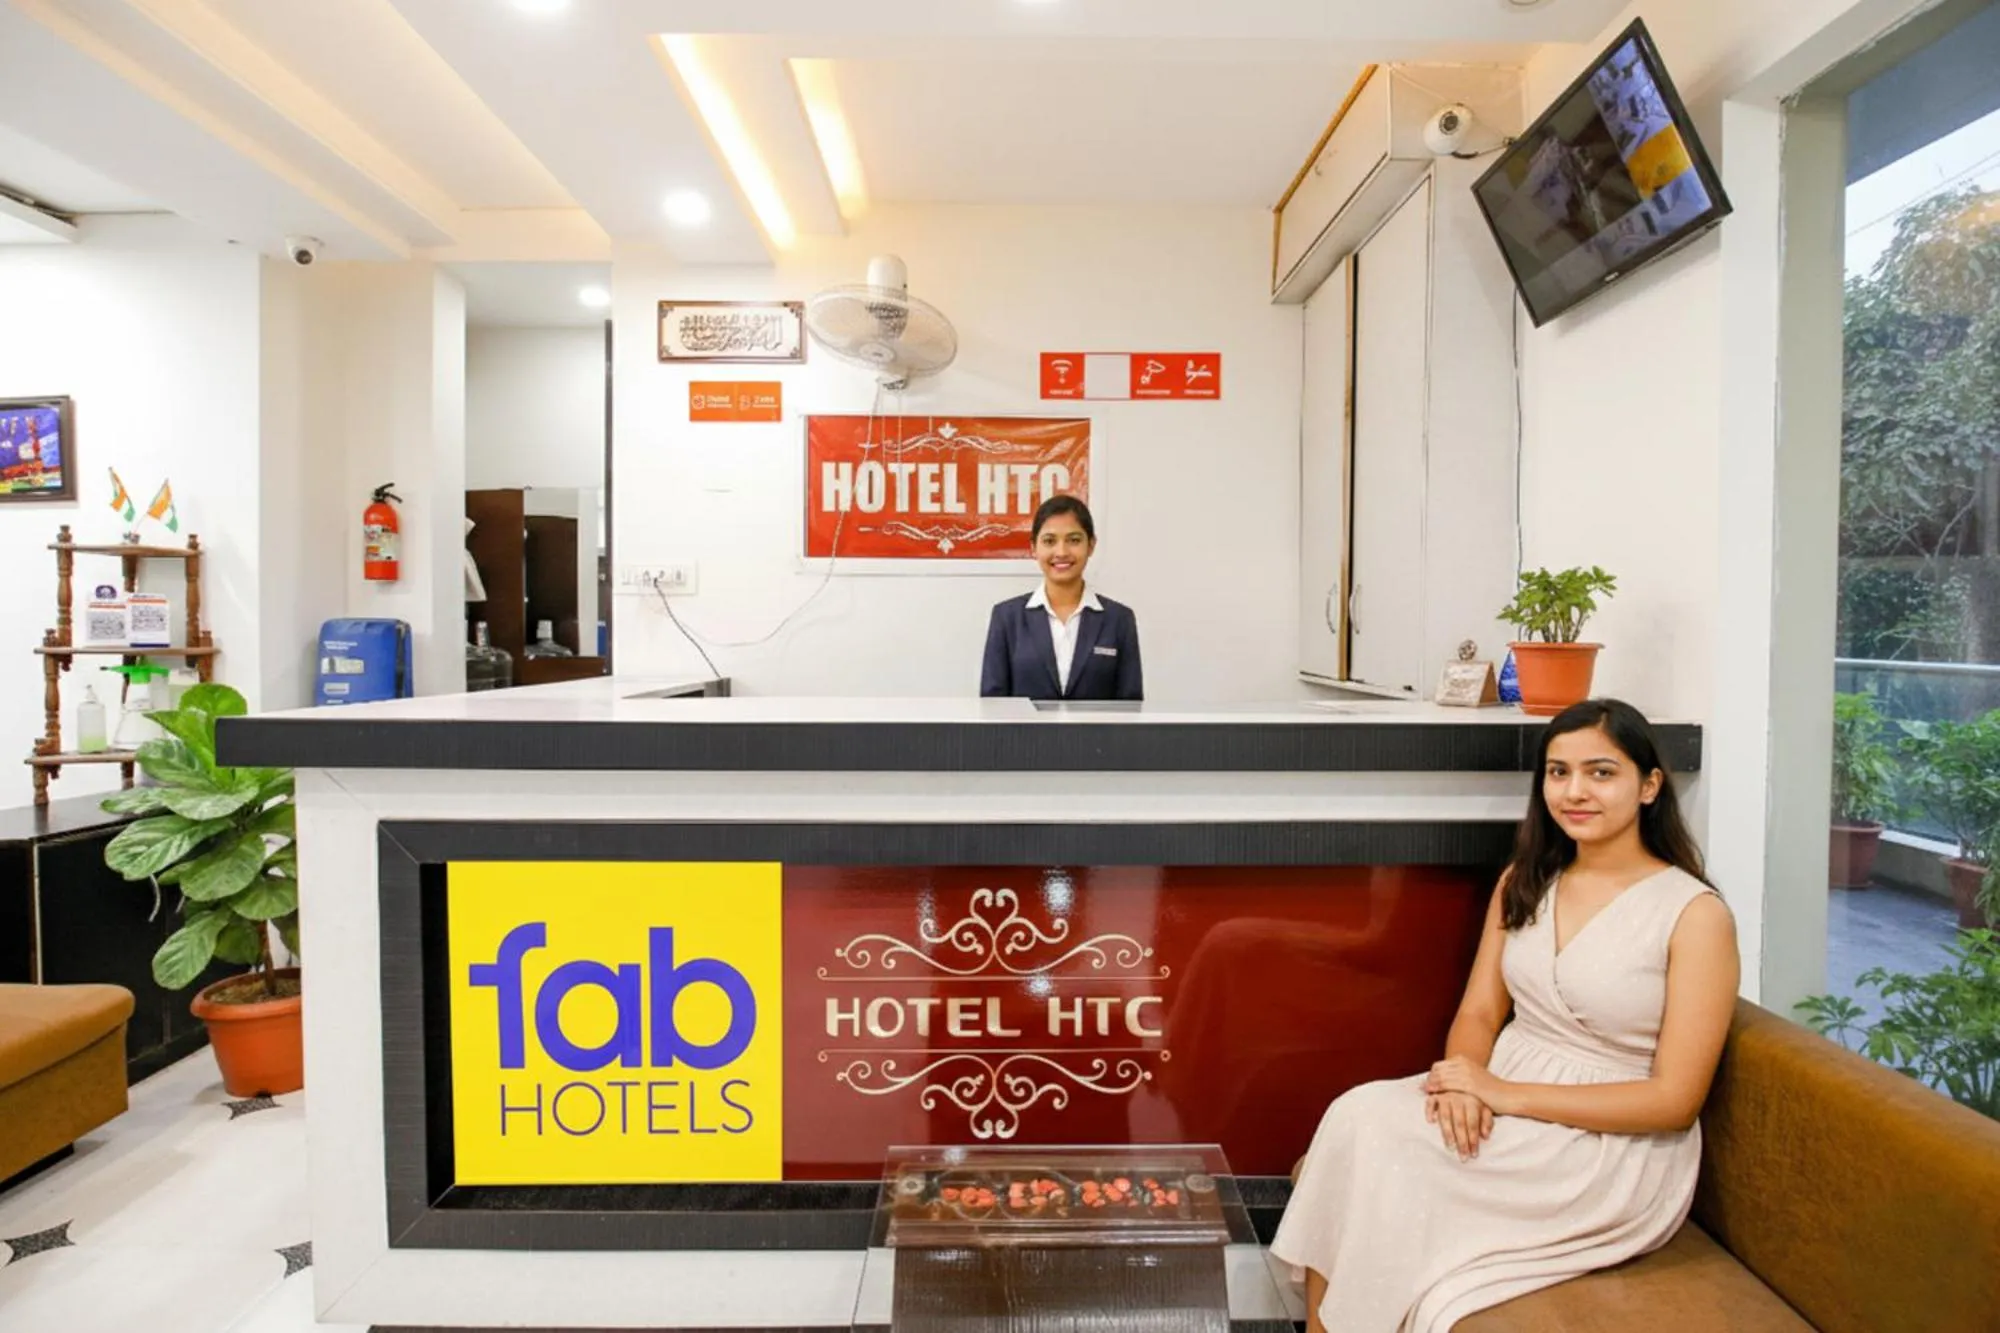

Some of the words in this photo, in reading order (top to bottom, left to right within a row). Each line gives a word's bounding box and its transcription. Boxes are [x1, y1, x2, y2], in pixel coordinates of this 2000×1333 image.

[822, 461, 967, 513] HOTEL
[469, 922, 757, 1072] fab
[825, 996, 1021, 1037] HOTEL
[1047, 996, 1163, 1037] HTC
[501, 1079, 753, 1136] HOTELS
